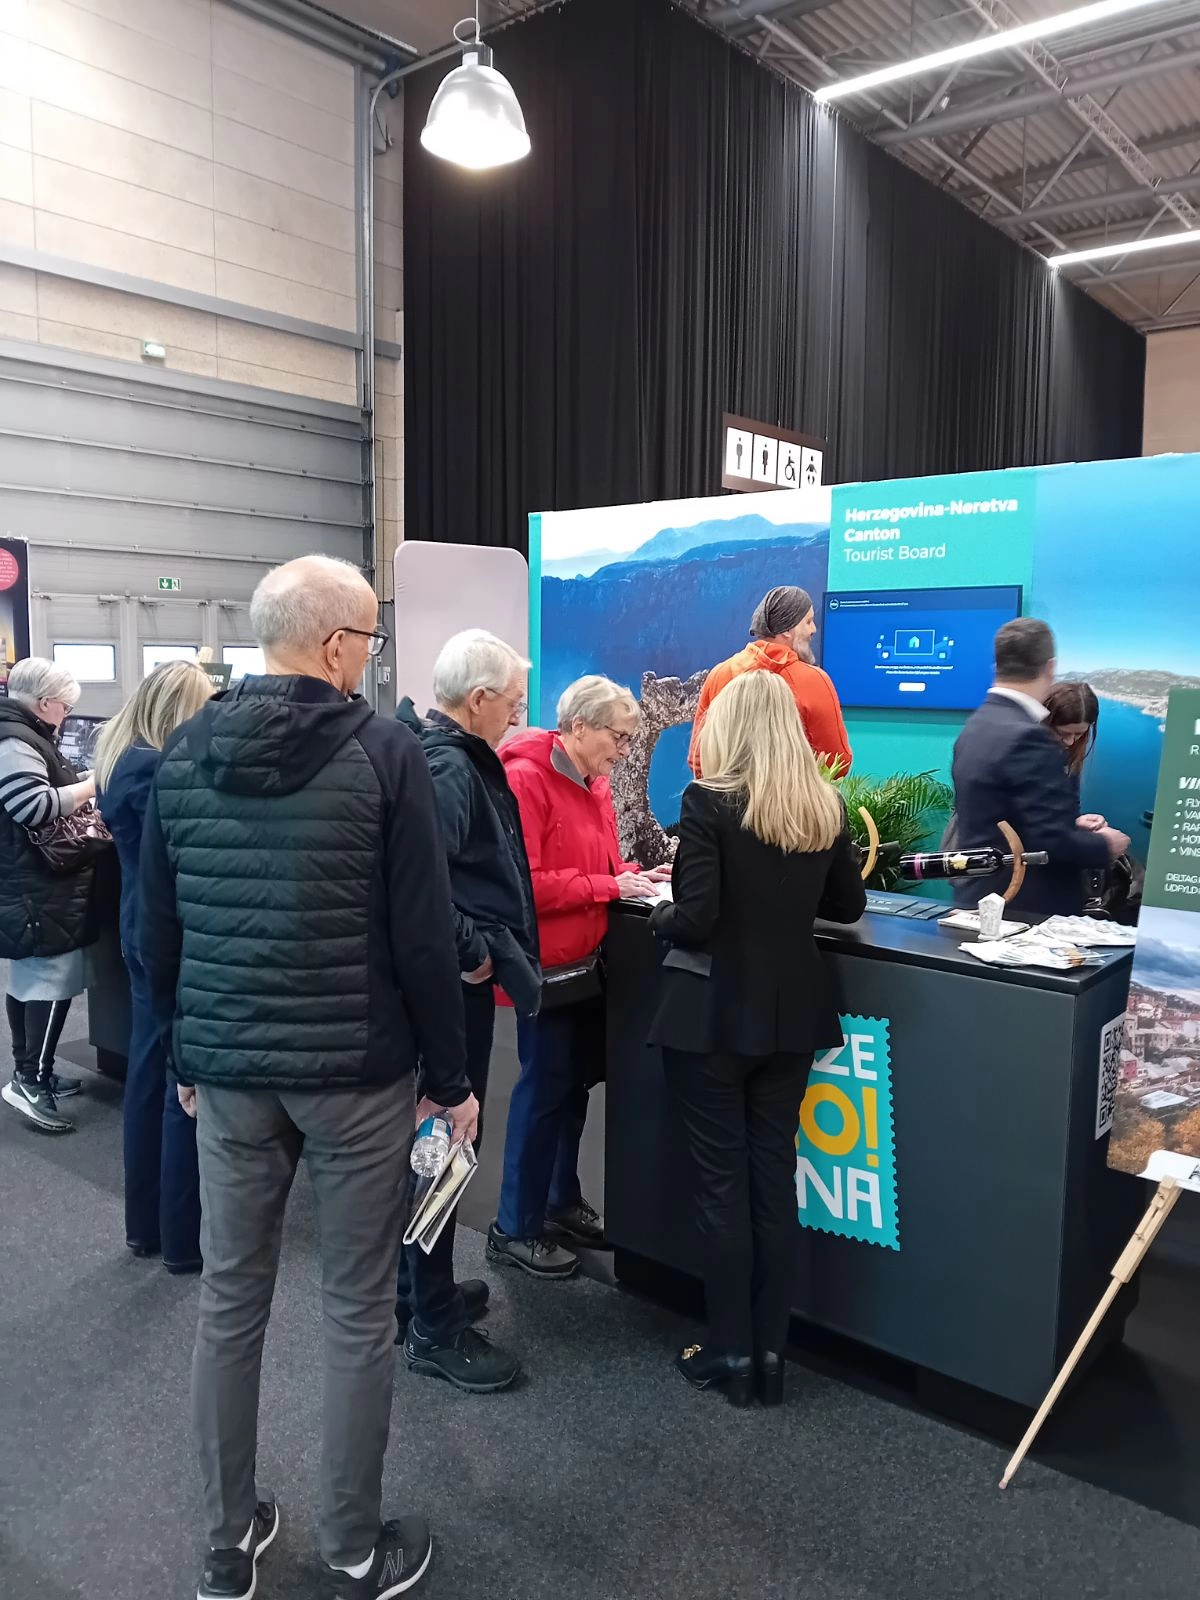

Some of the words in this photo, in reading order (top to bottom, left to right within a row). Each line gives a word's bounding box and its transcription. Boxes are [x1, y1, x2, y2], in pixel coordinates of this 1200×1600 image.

[845, 498, 1018, 523] Herzegovina-Neretva
[844, 527, 900, 542] Canton
[843, 547, 894, 562] Tourist
[899, 543, 946, 560] Board
